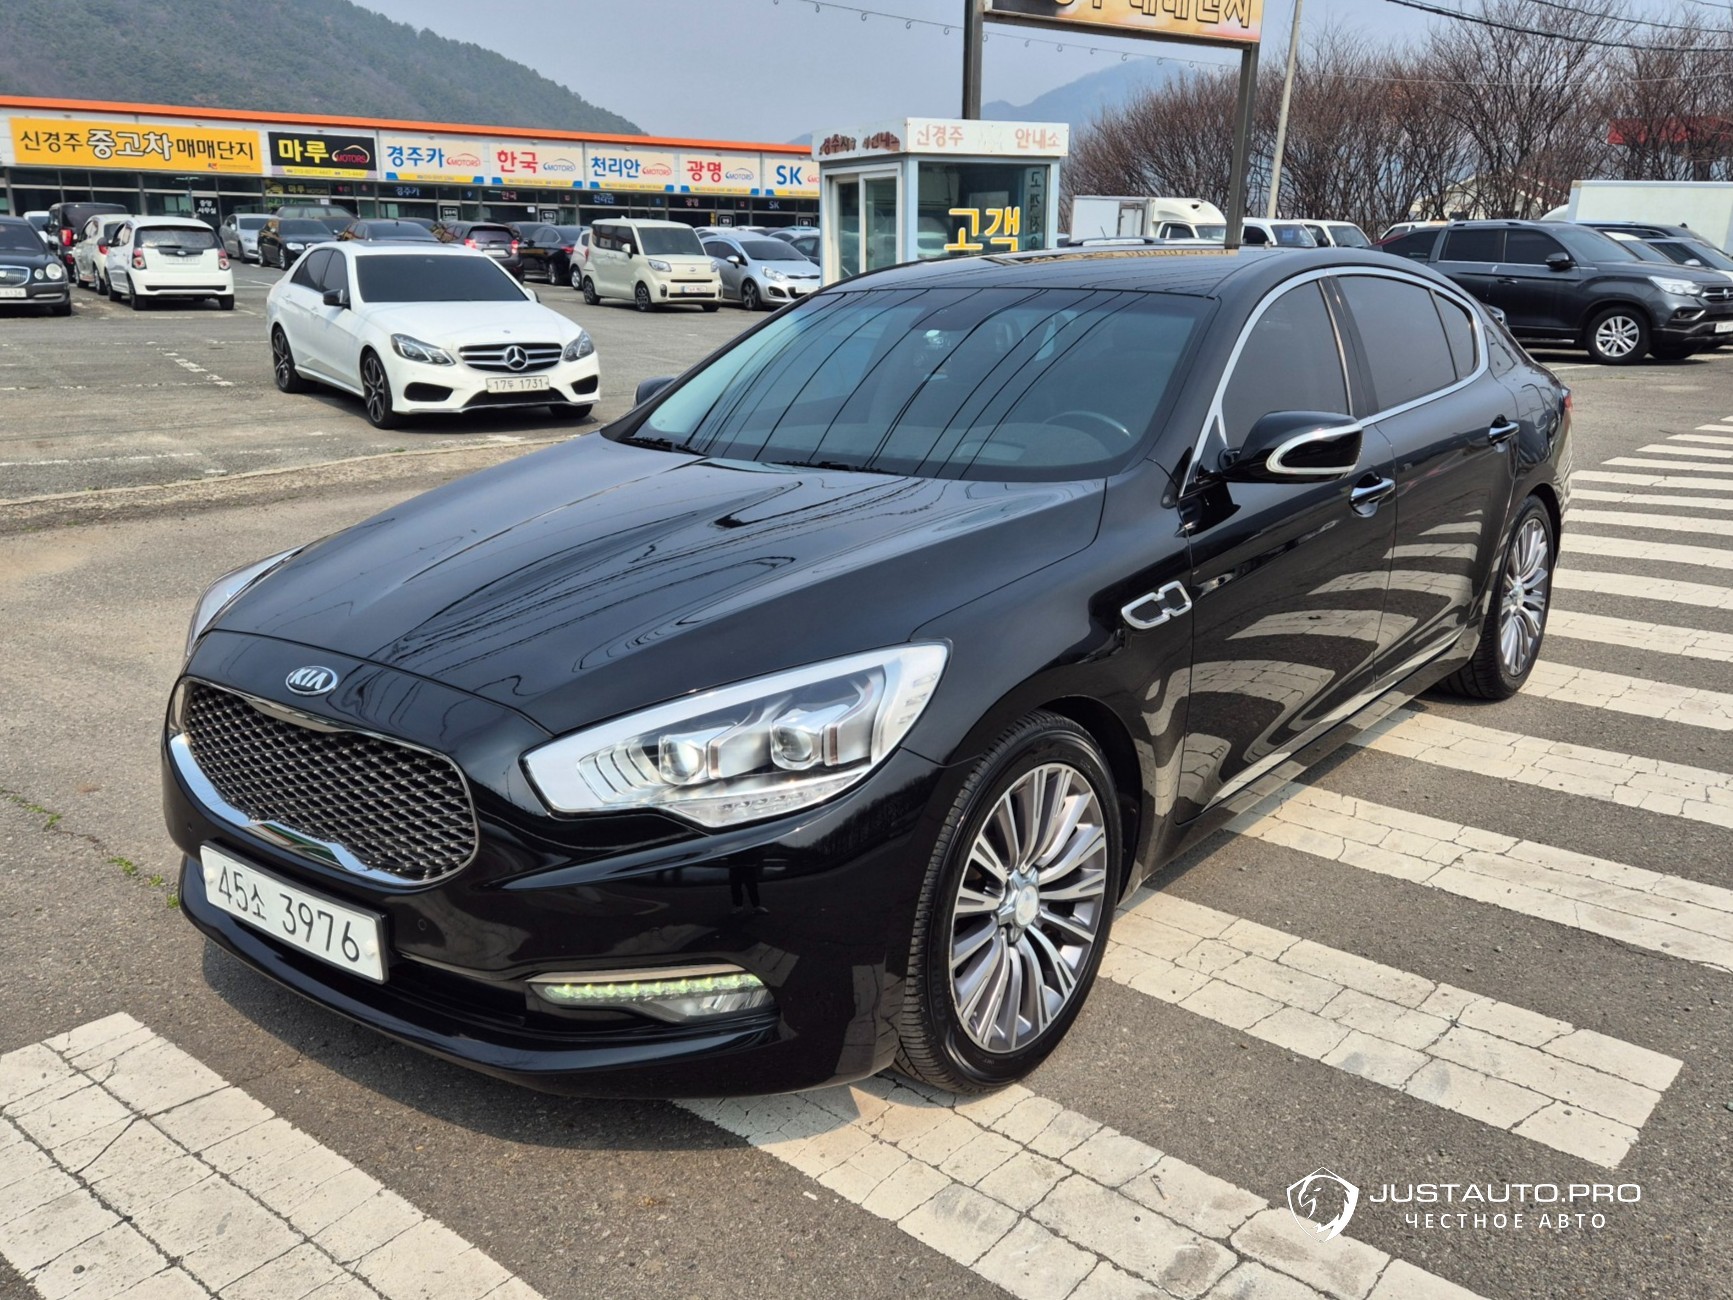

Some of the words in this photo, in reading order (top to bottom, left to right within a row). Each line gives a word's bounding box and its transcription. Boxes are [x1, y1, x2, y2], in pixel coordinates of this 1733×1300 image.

[20, 130, 83, 153] 신경주
[87, 129, 173, 161] 중고차
[176, 138, 254, 161] 매매단지
[916, 124, 964, 147] 신경주
[1014, 128, 1061, 149] 안내소
[278, 139, 329, 164] 마루
[336, 154, 367, 164] MOTORS
[386, 146, 445, 168] 경주카
[497, 150, 538, 174] 한국
[547, 164, 576, 172] MOTORS
[591, 156, 641, 178] 천리안
[687, 161, 722, 183] 광명
[776, 165, 802, 185] SK
[944, 206, 1020, 251] 고객
[520, 378, 543, 390] 1731
[288, 667, 328, 690] KIA
[217, 865, 267, 921] 45소
[279, 892, 360, 963] 3976
